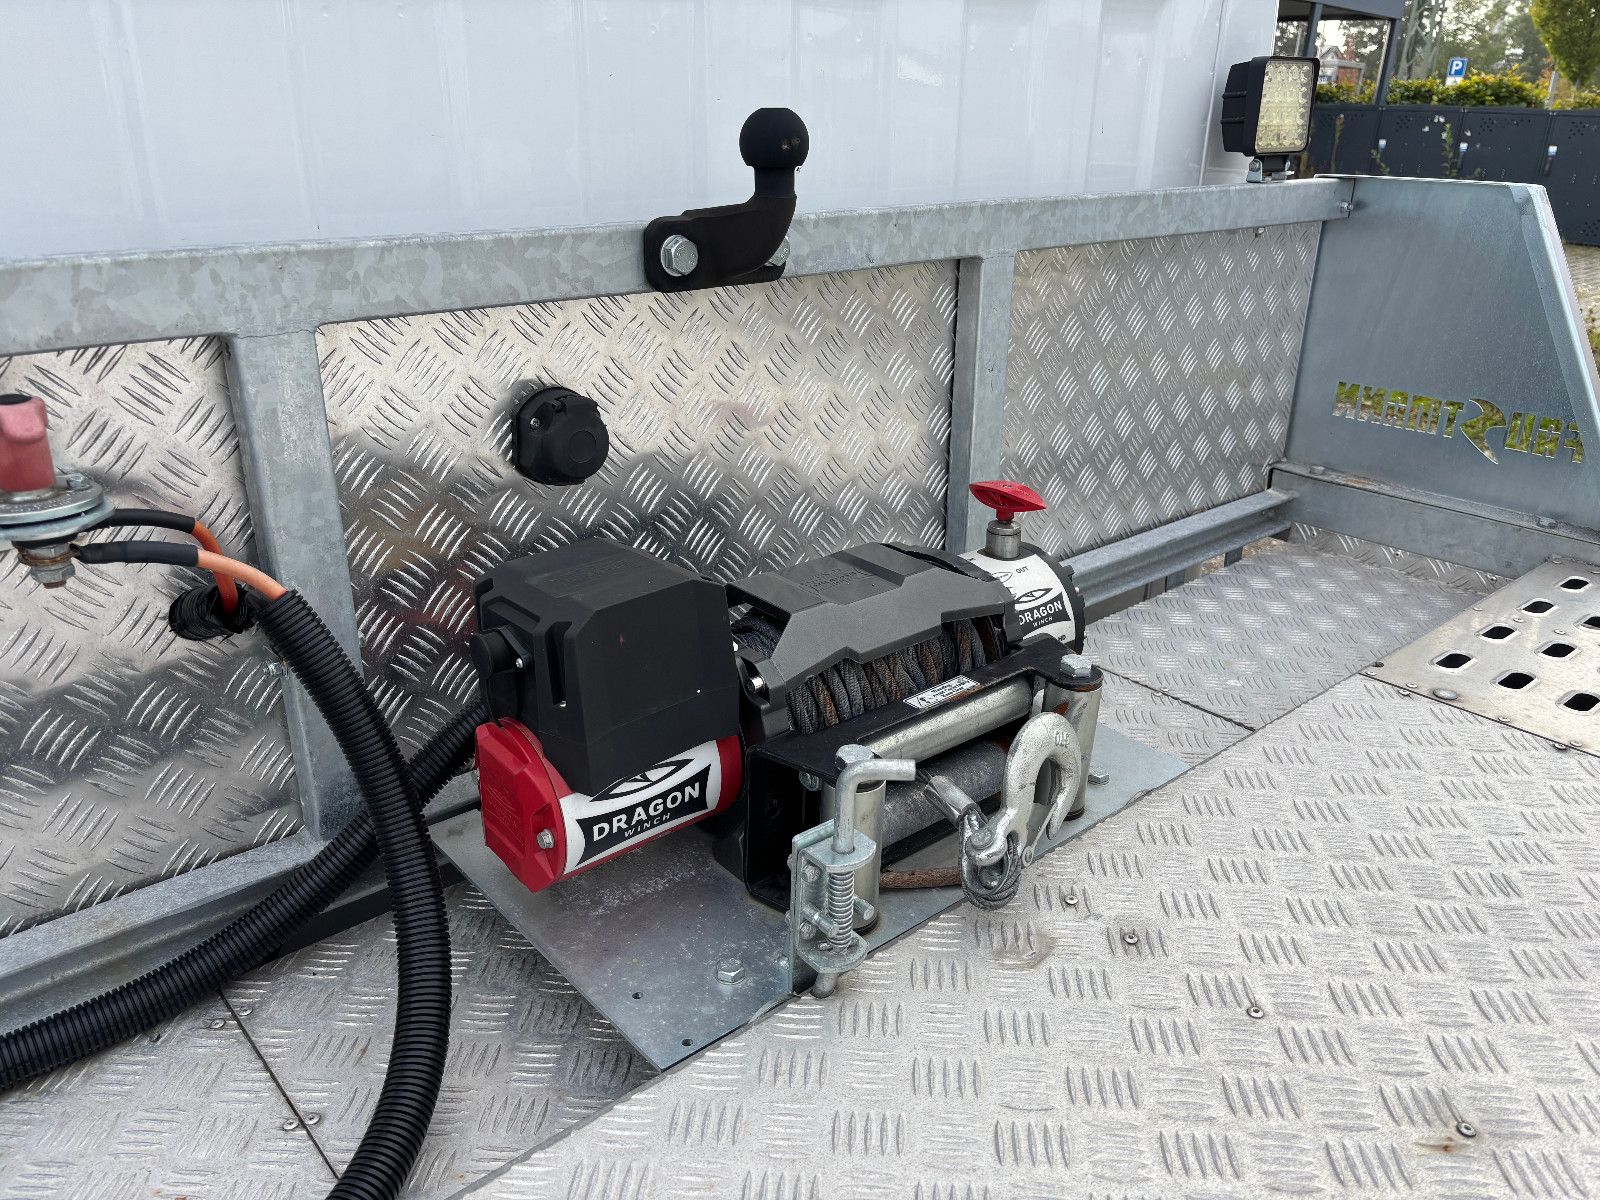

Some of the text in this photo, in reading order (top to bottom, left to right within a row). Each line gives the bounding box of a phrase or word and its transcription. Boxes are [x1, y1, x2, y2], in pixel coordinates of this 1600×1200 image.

[1451, 60, 1462, 75] P
[1015, 565, 1029, 574] OUT
[1018, 600, 1063, 626] DRAGON
[1032, 616, 1053, 628] WINCH
[592, 781, 700, 842] DRAGON
[624, 812, 671, 838] WINCH
